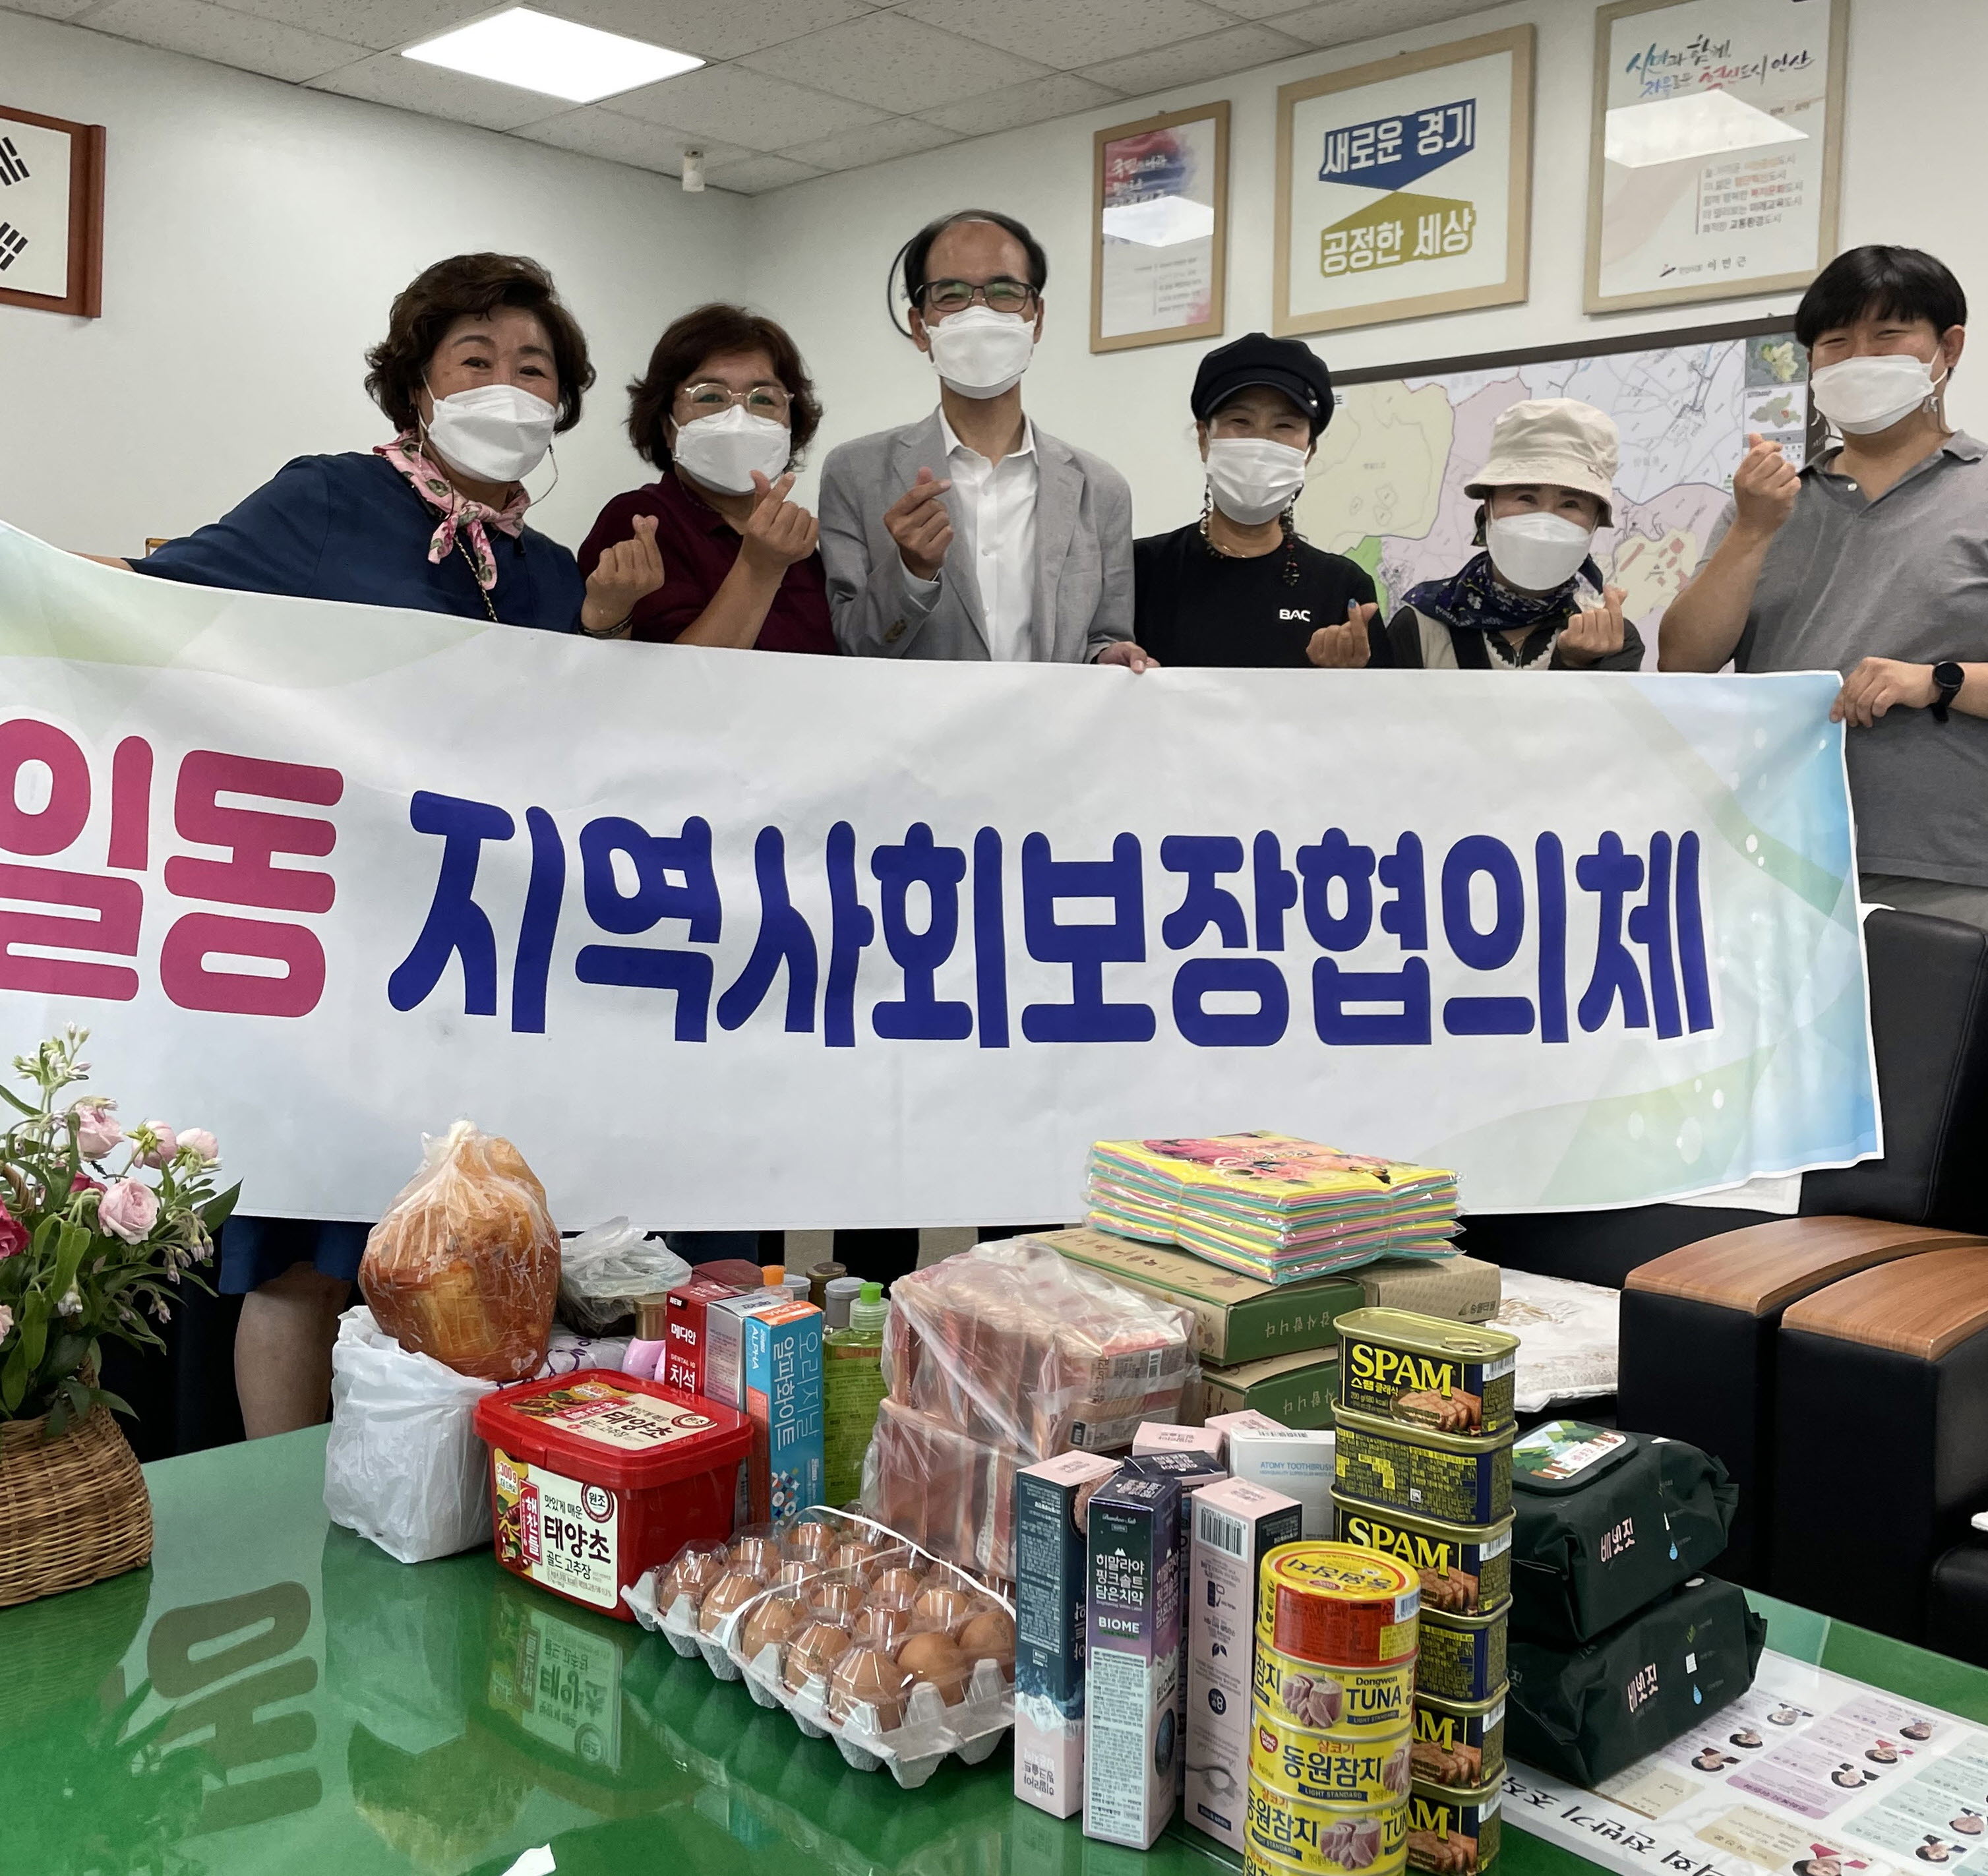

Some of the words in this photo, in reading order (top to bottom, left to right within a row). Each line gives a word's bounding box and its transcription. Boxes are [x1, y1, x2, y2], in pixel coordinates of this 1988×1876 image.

[1770, 49, 1815, 73] 안산
[1322, 120, 1402, 175] 새로운
[1418, 104, 1472, 156] 경기
[1323, 220, 1403, 273] 공정한
[1413, 208, 1473, 257] 세상
[1279, 609, 1311, 622] BAC
[0, 718, 344, 1018] 일동
[388, 790, 1714, 1049] 지역사회보장협의체
[671, 1323, 697, 1346] 메디안
[1265, 1312, 1330, 1339] 감사합니다
[670, 1364, 696, 1393] 치석
[1351, 1344, 1454, 1397] SPAM
[773, 1337, 795, 1451] 알파화이트
[797, 1331, 820, 1440] 오리지날
[1351, 1377, 1374, 1392] 스팸
[1375, 1381, 1399, 1397] 클래식
[1282, 1387, 1335, 1416] 사합니다
[600, 1411, 673, 1439] 태양초
[1286, 1462, 1333, 1471] TOOTHBRUSH
[544, 1494, 566, 1515] 맛있게
[567, 1503, 583, 1520] 매운
[589, 1492, 605, 1508] 원조
[525, 1496, 539, 1557] 해찬들
[544, 1515, 611, 1564] 태양초
[1348, 1517, 1451, 1577] SPAM
[547, 1550, 562, 1569] 골드
[565, 1558, 591, 1580] 고추장
[1096, 1554, 1145, 1575] 히말라야
[1096, 1569, 1145, 1590] 핑크솔트
[1096, 1585, 1145, 1606] 담은치약
[1099, 1616, 1140, 1634] BIOME
[1157, 1668, 1176, 1700] BIOME
[1346, 1687, 1402, 1710] TUNA
[1371, 1711, 1398, 1723] STANDARD
[1317, 1740, 1356, 1755] 살코기
[1283, 1744, 1383, 1788] 동원참치
[1305, 1788, 1325, 1798] LIGHT
[1327, 1790, 1362, 1800] STANDARD
[1247, 1789, 1319, 1847] 동원참치
[1561, 1805, 1656, 1855] 전반기
